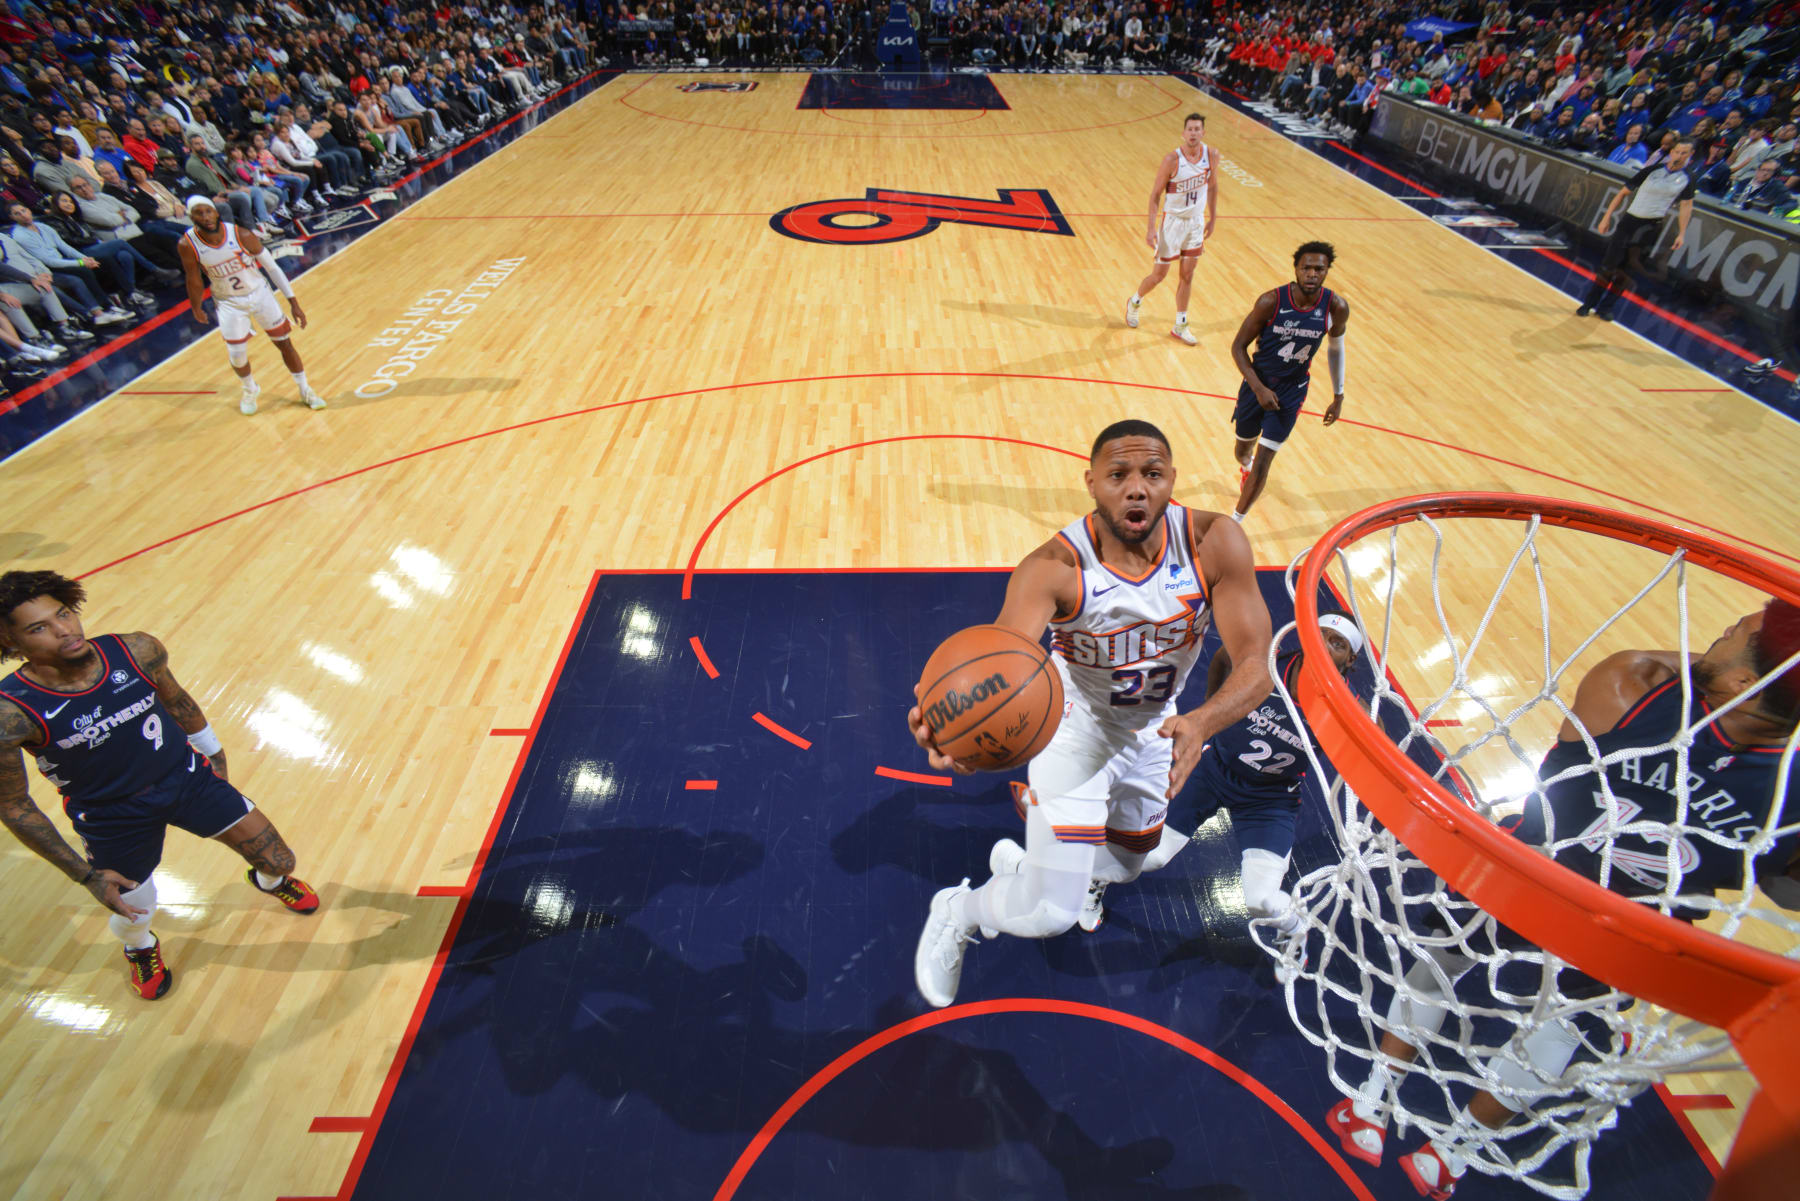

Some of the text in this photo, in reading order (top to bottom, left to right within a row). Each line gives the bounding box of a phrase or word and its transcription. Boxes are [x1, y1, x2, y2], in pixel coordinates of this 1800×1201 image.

[1416, 118, 1548, 204] BETMGM
[1175, 173, 1206, 193] SUNS
[1185, 191, 1198, 207] 14
[228, 276, 244, 290] 2
[354, 255, 527, 399] WELLS FARGO
[367, 288, 453, 347] CENTER
[1272, 325, 1323, 338] BROTHERLY
[1277, 341, 1312, 363] 44
[1164, 578, 1193, 591] PayPal
[1072, 619, 1187, 668] SUNS
[1110, 664, 1177, 706] 23
[56, 691, 156, 750] BROTHERLY
[72, 705, 103, 731] City of
[923, 672, 1011, 735] Wilson
[1260, 705, 1277, 719] City
[142, 713, 164, 751] 9
[1246, 723, 1267, 736] Love
[1238, 739, 1296, 775] 22
[1577, 791, 1700, 890] 12
